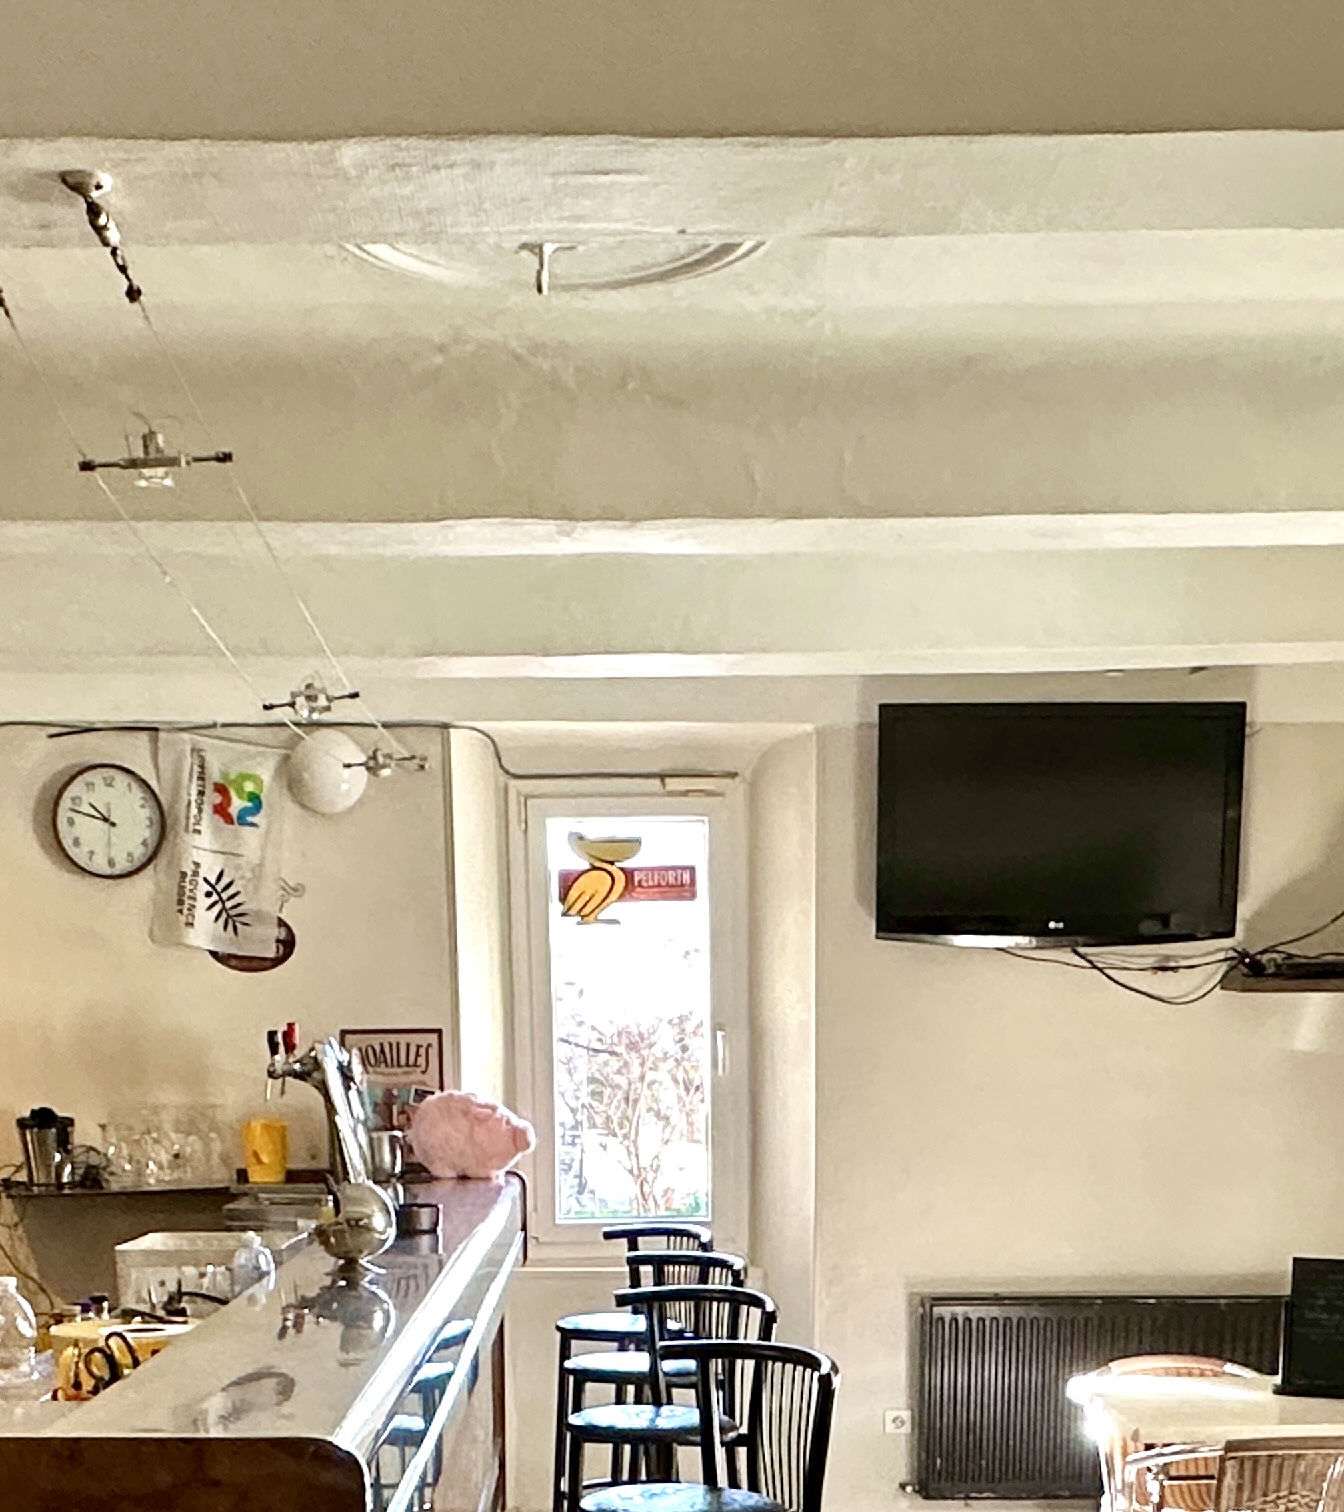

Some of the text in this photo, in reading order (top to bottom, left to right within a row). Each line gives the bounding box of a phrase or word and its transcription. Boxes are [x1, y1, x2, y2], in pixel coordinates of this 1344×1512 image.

[102, 775, 116, 788] 12
[87, 849, 96, 862] 7
[634, 869, 691, 887] PELFORTH
